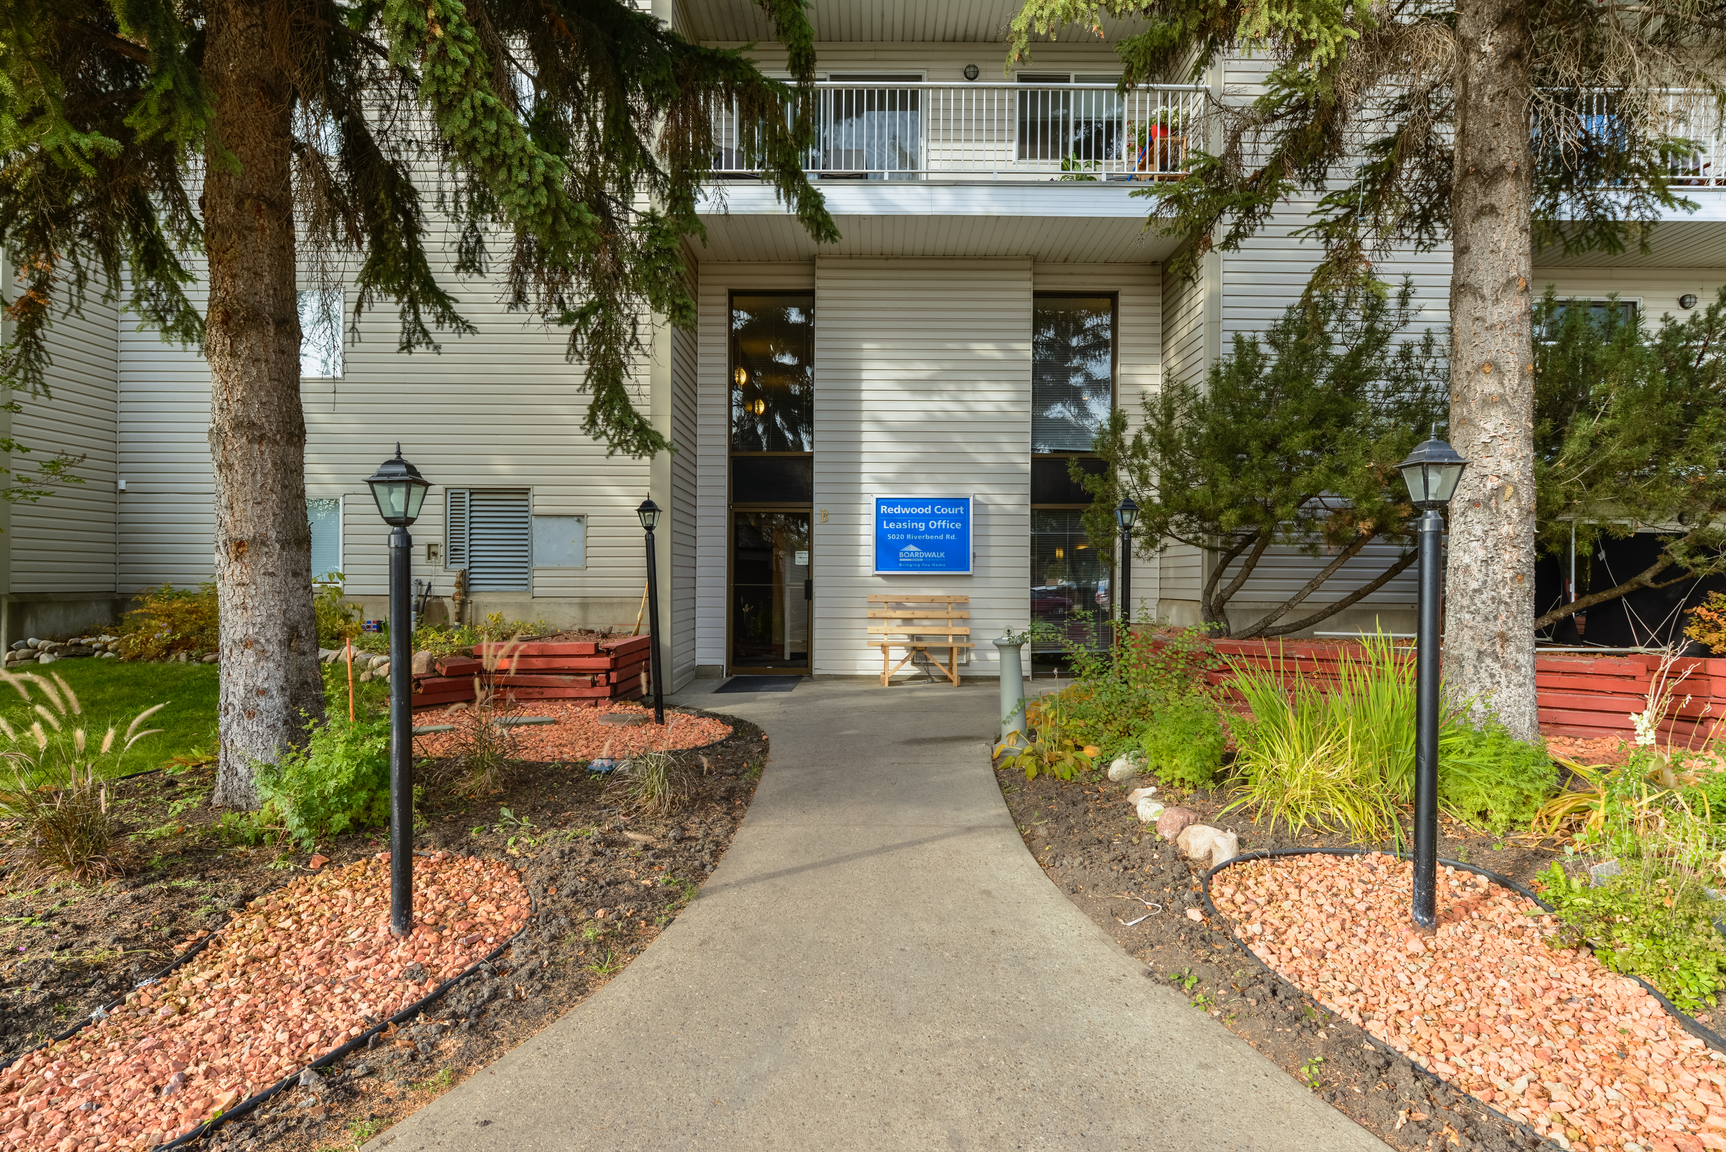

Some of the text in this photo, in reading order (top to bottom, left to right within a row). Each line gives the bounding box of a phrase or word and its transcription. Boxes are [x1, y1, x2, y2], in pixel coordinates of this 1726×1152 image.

[880, 505, 964, 514] Redwood Court
[820, 509, 829, 523] B
[883, 520, 962, 531] Leasing Office
